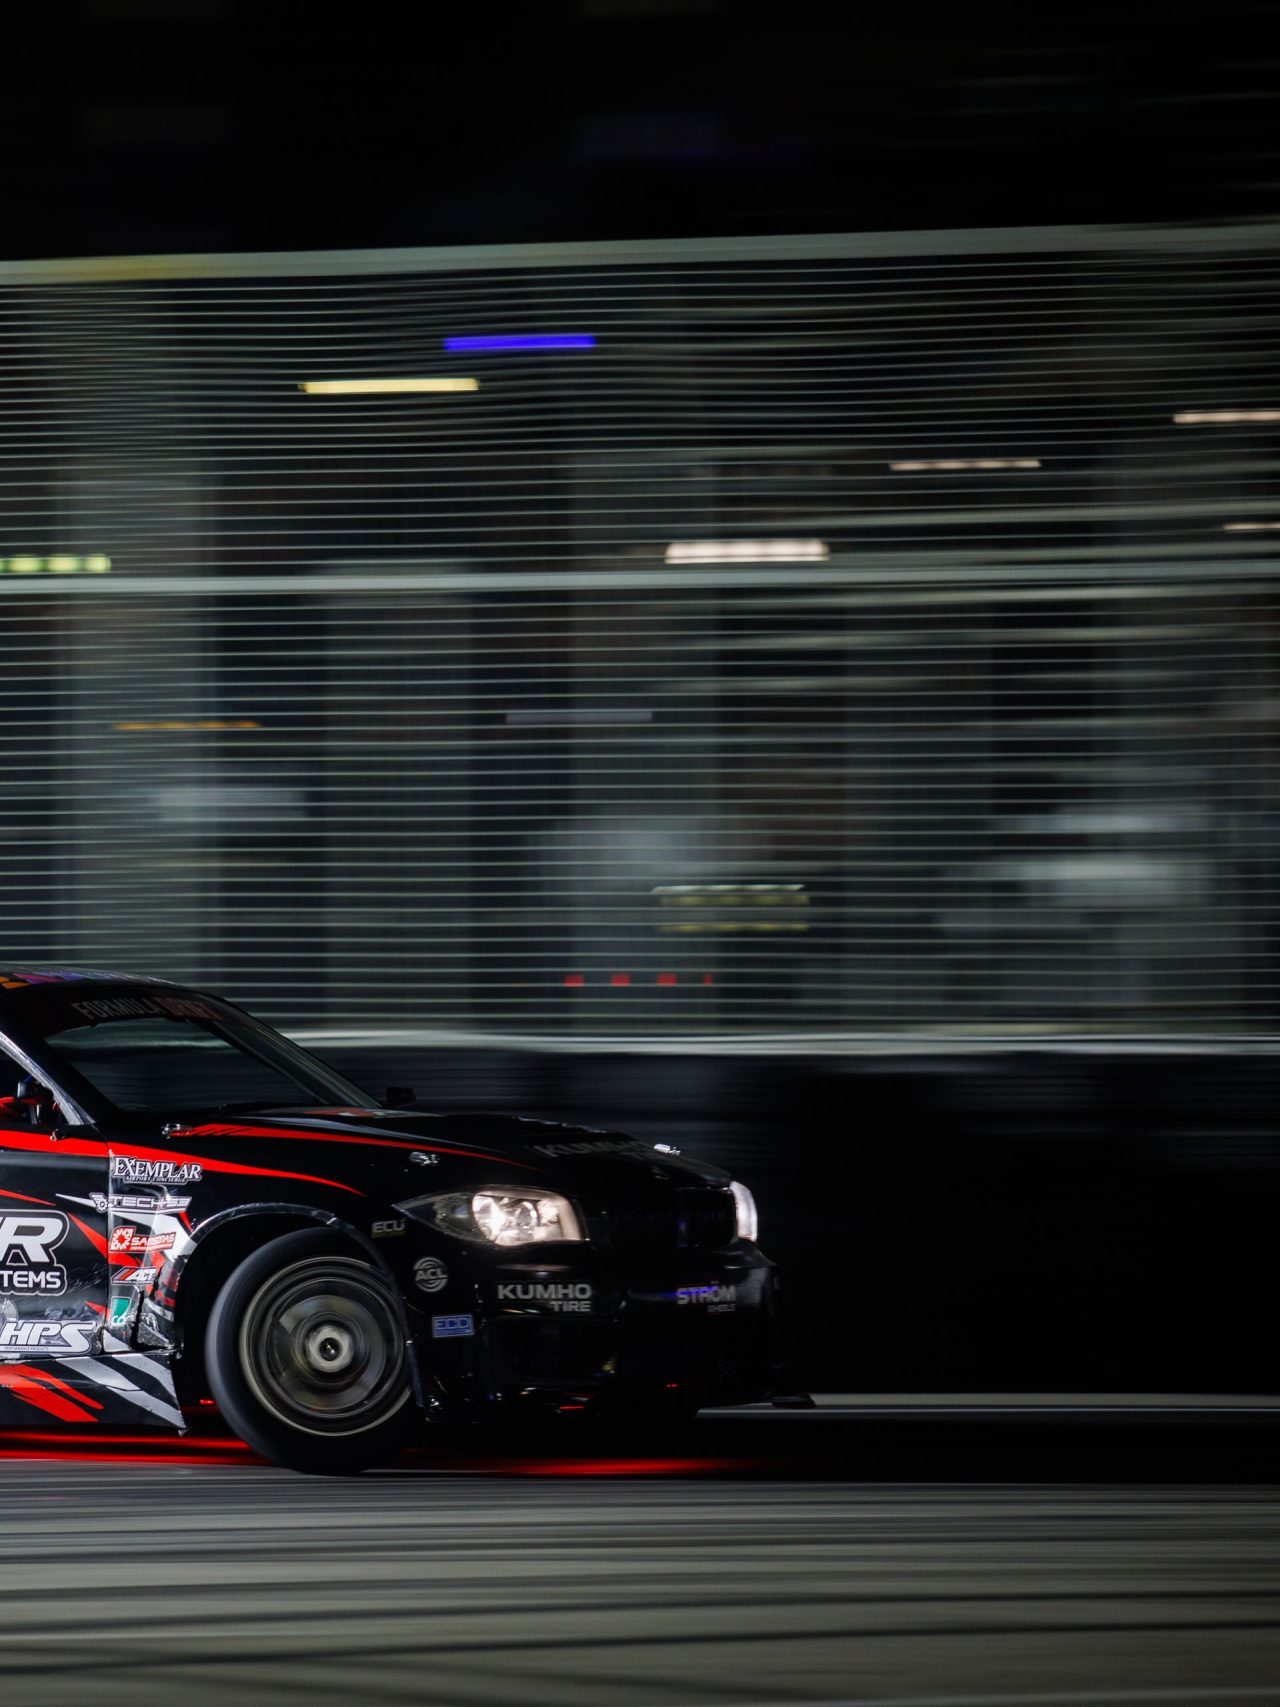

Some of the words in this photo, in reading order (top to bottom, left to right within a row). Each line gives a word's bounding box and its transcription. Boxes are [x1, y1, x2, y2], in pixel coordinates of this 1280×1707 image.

[113, 1157, 202, 1180] EXEMPLAR
[372, 1219, 406, 1233] ECU
[414, 1267, 449, 1282] ACL
[497, 1284, 592, 1300] KUMHO
[551, 1300, 592, 1312] TIRE
